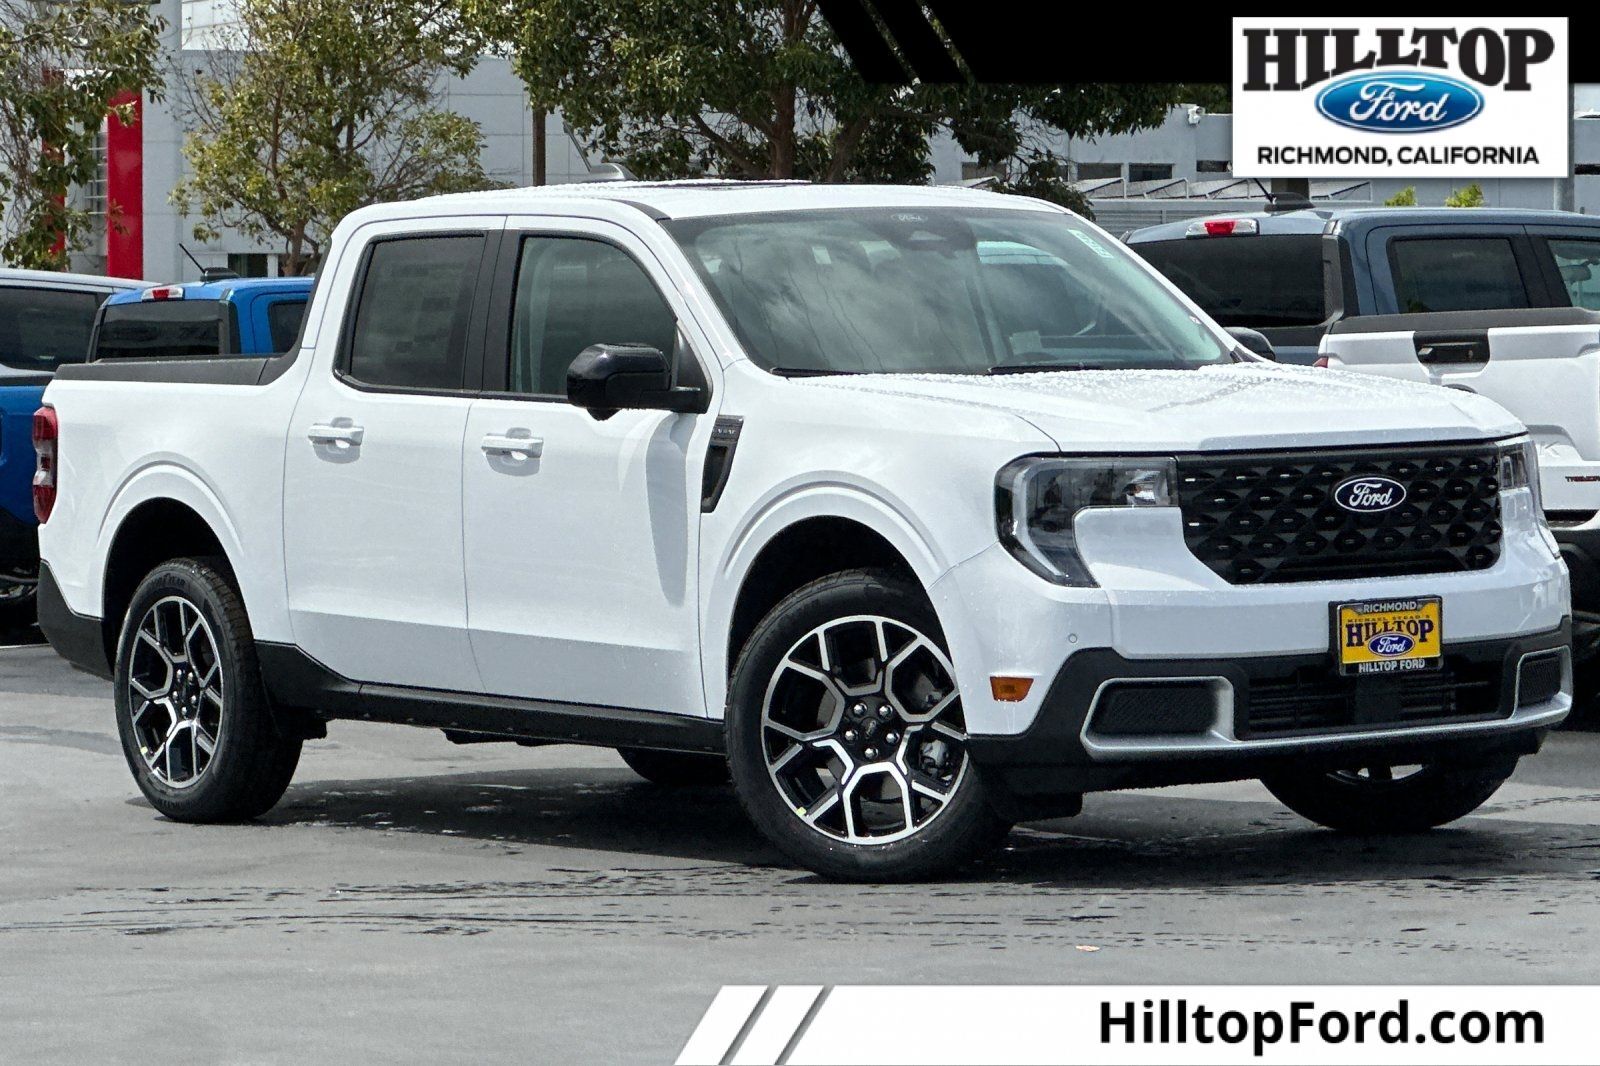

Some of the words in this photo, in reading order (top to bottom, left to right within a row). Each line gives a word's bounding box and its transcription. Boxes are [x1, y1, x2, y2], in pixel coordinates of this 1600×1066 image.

[1348, 482, 1393, 507] Ford
[1363, 601, 1417, 613] RICHMOND
[1345, 619, 1434, 647] HILLTOP
[1377, 636, 1406, 653] Ford
[1359, 660, 1397, 673] HILLTOP
[1400, 658, 1426, 671] FORD
